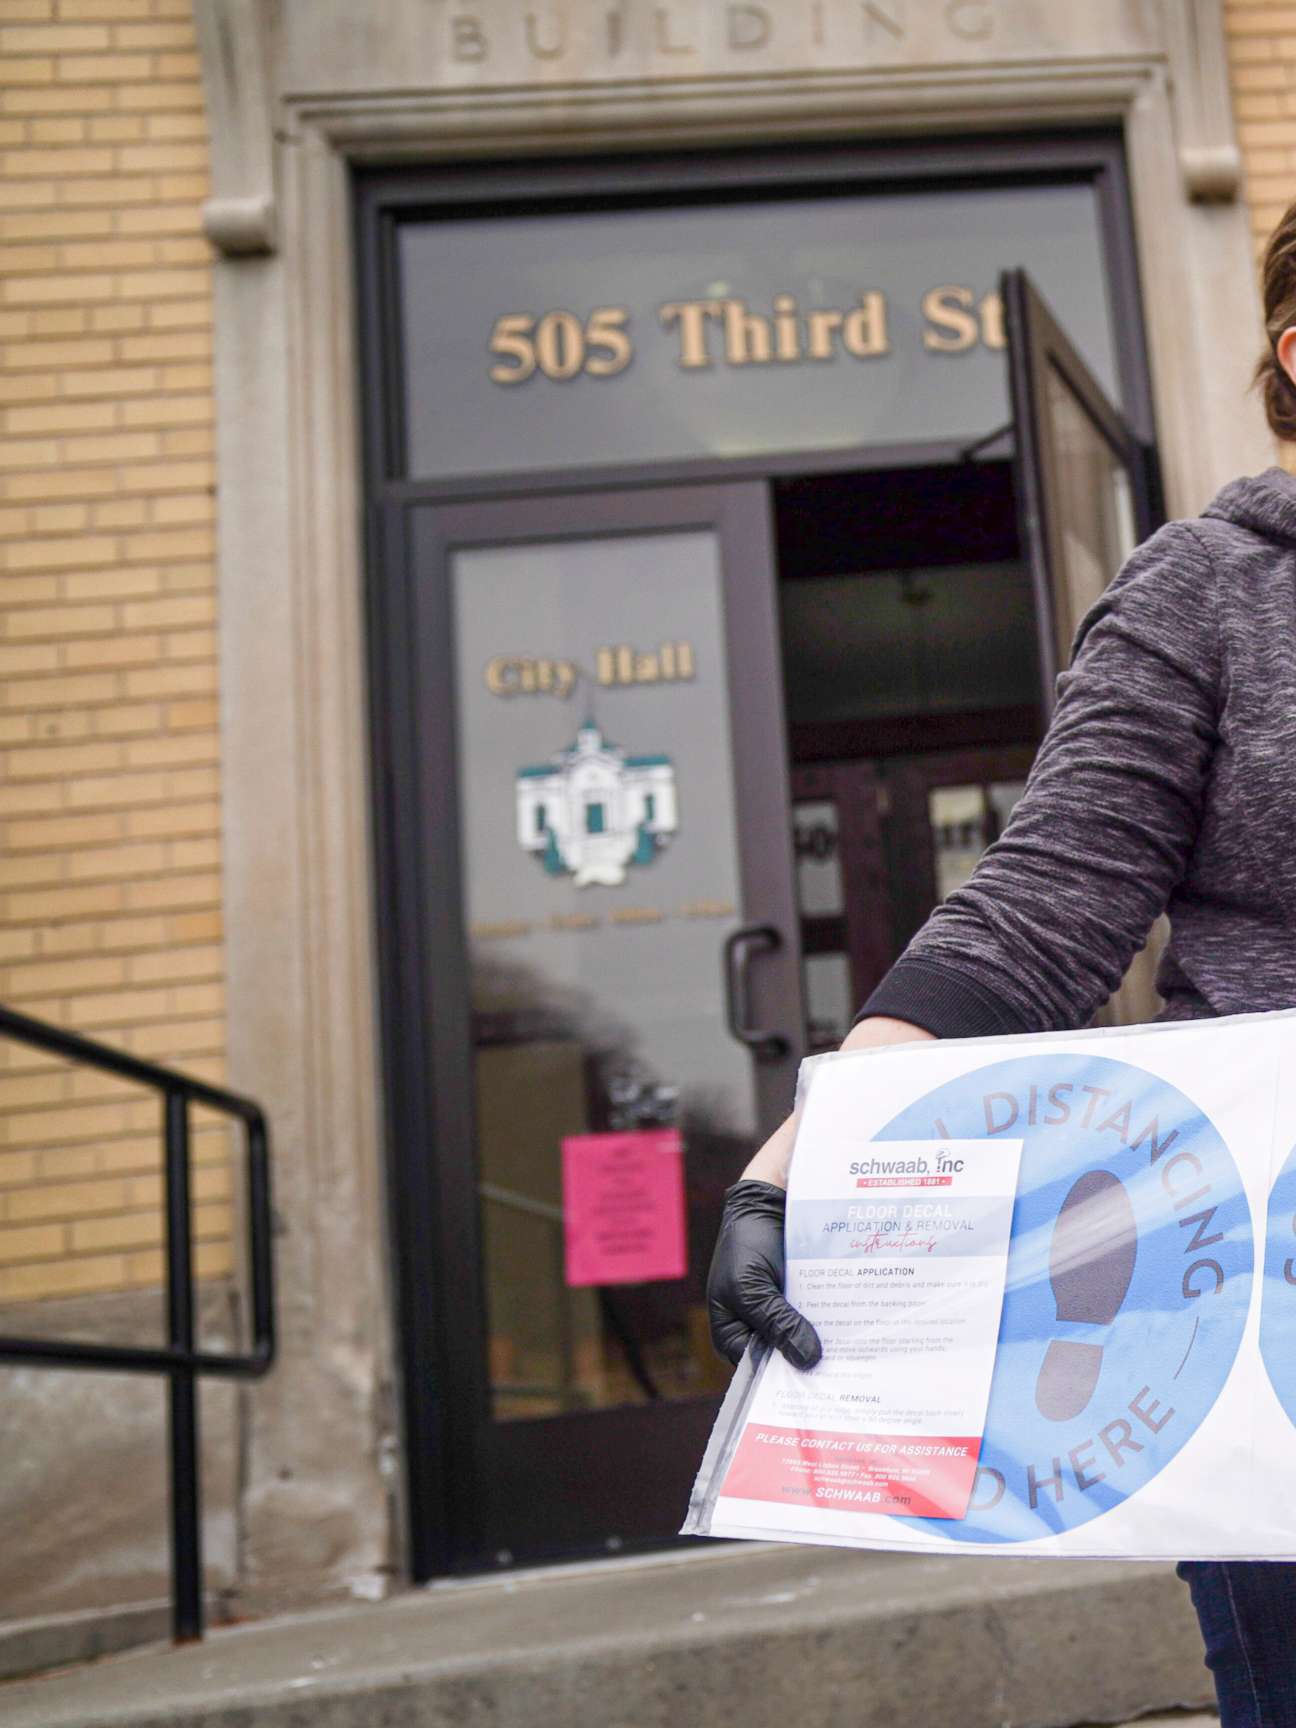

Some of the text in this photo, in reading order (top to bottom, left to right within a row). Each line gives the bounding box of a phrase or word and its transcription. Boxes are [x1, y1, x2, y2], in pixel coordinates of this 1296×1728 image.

[450, 0, 995, 63] BUILDING
[489, 306, 633, 384] 505
[659, 292, 891, 368] Third
[485, 643, 694, 698] City Hall
[849, 1156, 930, 1175] schwaab,
[982, 1082, 1225, 1300] DISTANCING
[847, 1203, 953, 1219] FLOOR DECAL
[822, 1218, 975, 1233] APPLICATION & REMOVAL
[849, 1231, 938, 1253] instructions
[799, 1266, 915, 1278] FLOOR DECAL APPLICATION
[839, 1393, 881, 1404] REMOVAL
[755, 1432, 969, 1458] PLEASE CONTACT US FOR ASSISTANCE
[1026, 1385, 1176, 1510] HERE
